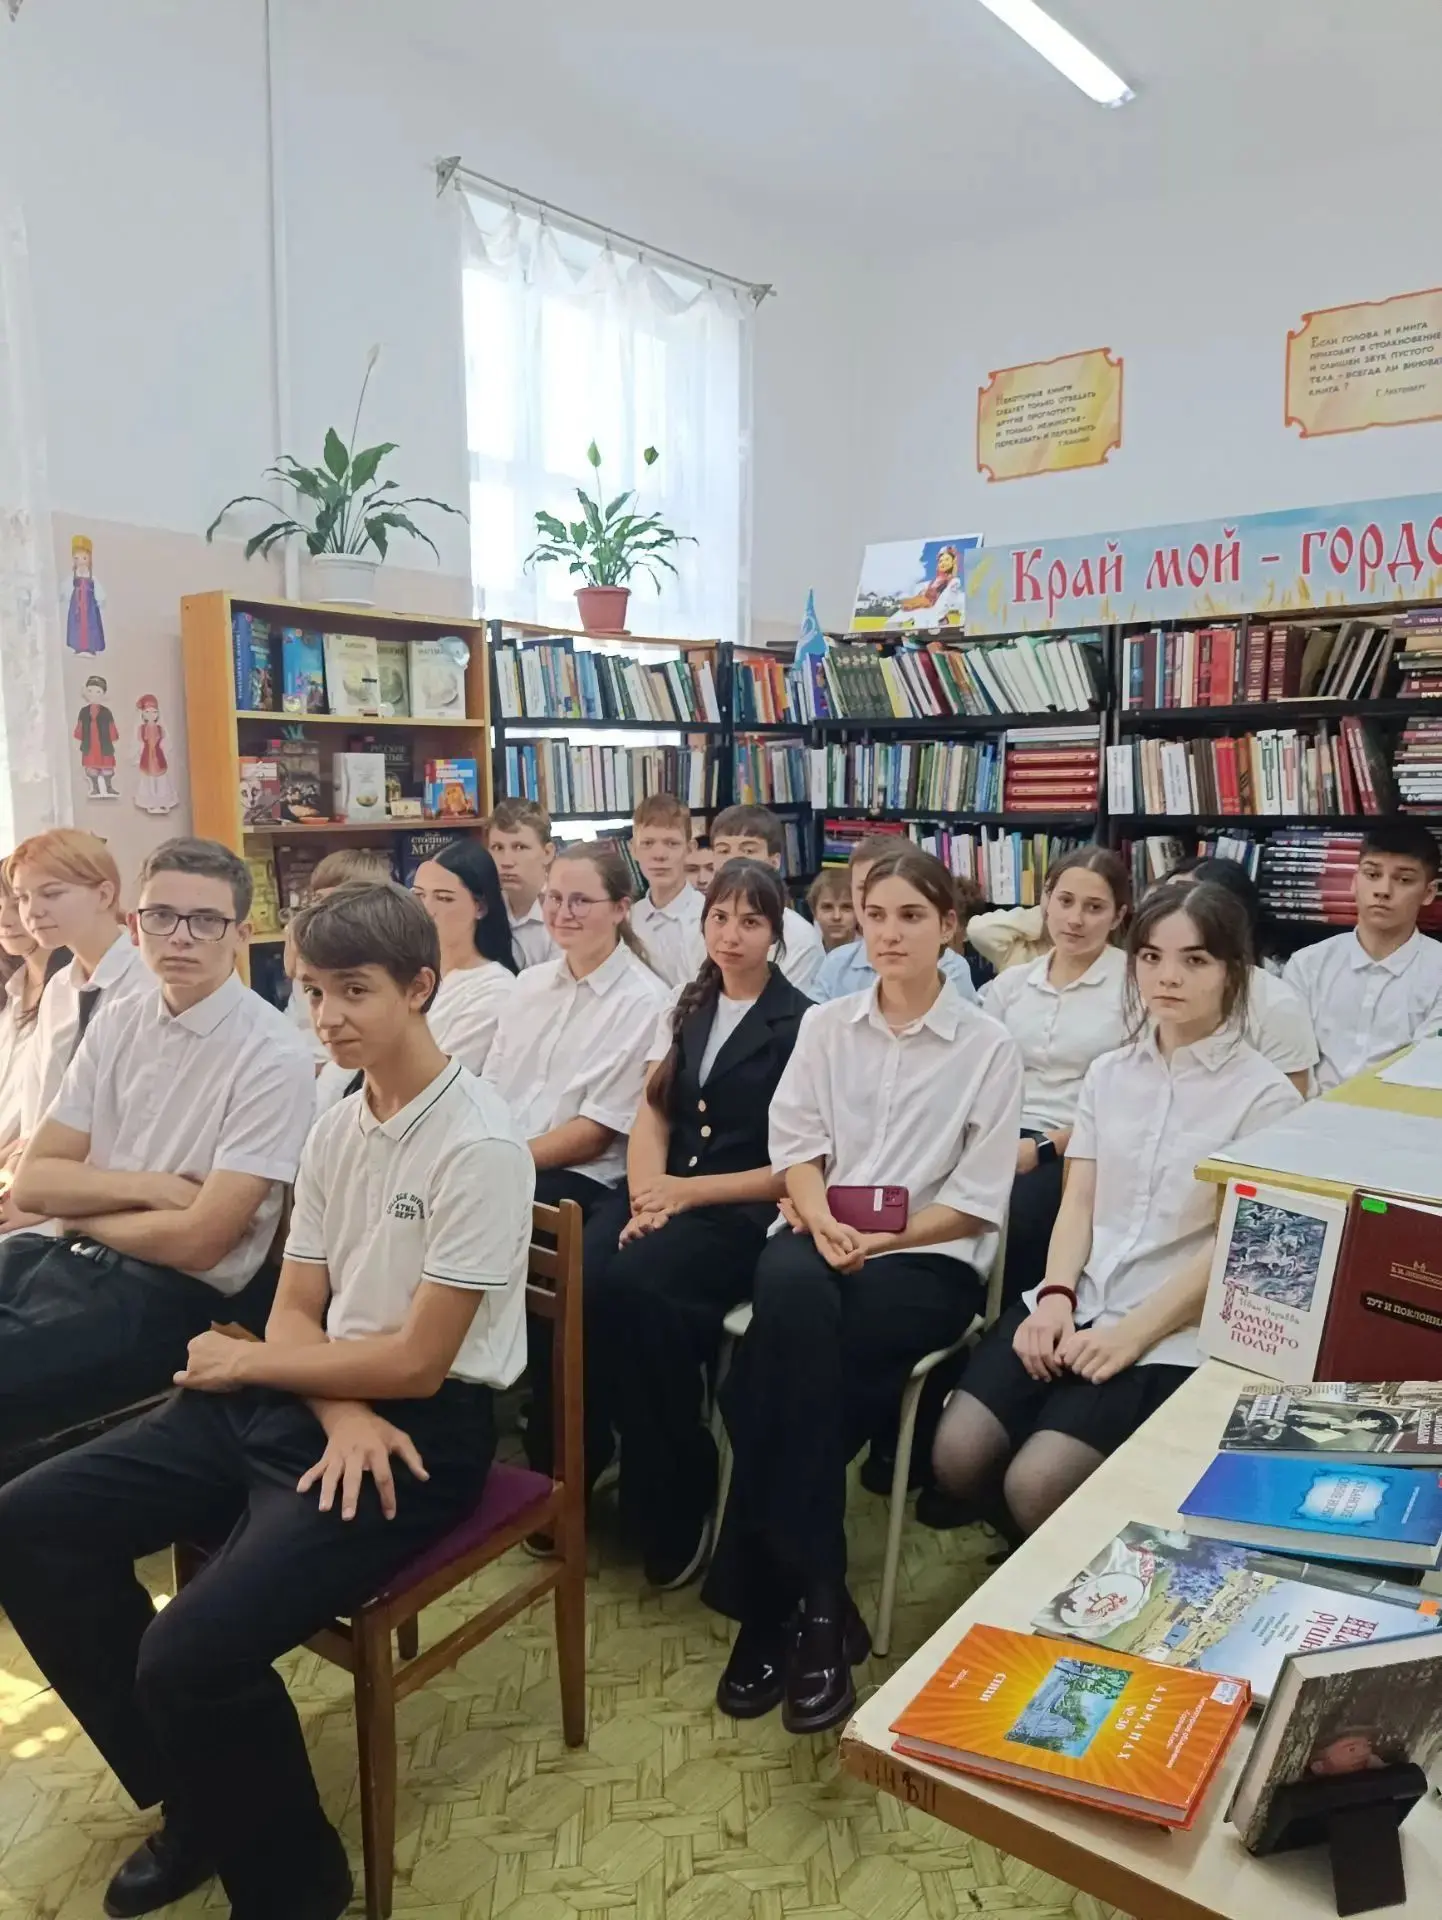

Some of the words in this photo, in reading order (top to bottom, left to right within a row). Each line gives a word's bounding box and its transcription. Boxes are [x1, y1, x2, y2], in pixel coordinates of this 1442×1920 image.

[1011, 538, 1124, 620] Край
[1146, 525, 1242, 591] мой
[1230, 1330, 1277, 1355] ПОЛЯ
[1116, 1684, 1167, 1760] АЛЬМАНАХ
